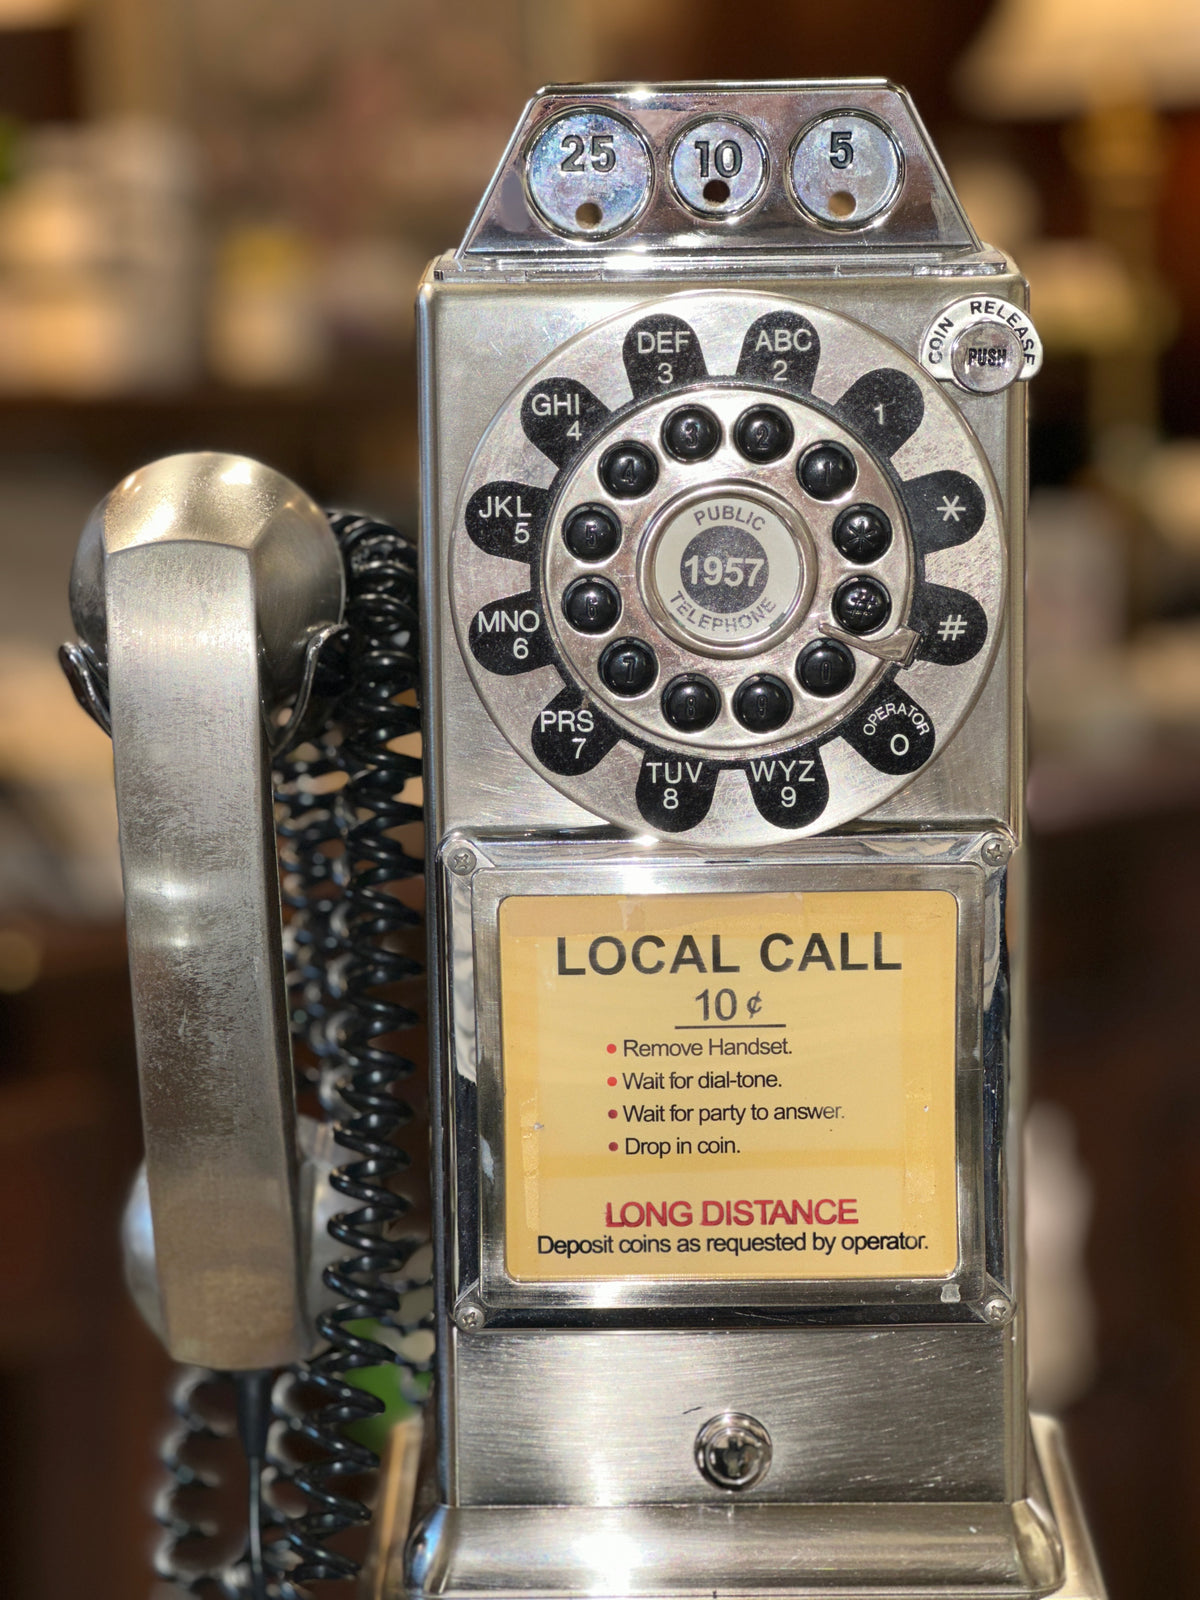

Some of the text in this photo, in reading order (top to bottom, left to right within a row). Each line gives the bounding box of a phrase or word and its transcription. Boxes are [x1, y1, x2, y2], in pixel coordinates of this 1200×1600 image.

[560, 135, 616, 172] 25
[694, 140, 743, 178] 10
[829, 131, 854, 169] 5
[637, 331, 691, 354] DEF
[755, 329, 812, 352] ABC
[928, 300, 1035, 365] COIN RELEASE
[967, 347, 1007, 366] PUSH
[657, 362, 674, 384] 3
[773, 360, 788, 381] 2
[531, 393, 580, 416] GHI
[873, 403, 884, 425] 1
[566, 420, 582, 441] 4
[478, 496, 533, 519] JKL
[693, 505, 766, 532] PUBLIC
[514, 522, 530, 544] 5
[684, 554, 765, 587] 1957
[478, 610, 540, 633] MNO
[670, 590, 777, 632] TELEPHONE
[512, 637, 529, 660] 6
[540, 710, 595, 733] PRS
[863, 703, 930, 736] OPERATOR
[571, 738, 587, 759] 7
[646, 761, 703, 784] TUV
[750, 760, 816, 783] WYZ
[662, 788, 679, 810] 8
[780, 786, 797, 808] 9
[556, 931, 903, 977] LOCAL CALL
[695, 987, 738, 1022] 10
[623, 1037, 793, 1058] Remove Handset.
[622, 1071, 783, 1090] Wait for dial-tone.
[622, 1103, 846, 1126] Wait for party to answer.
[625, 1136, 741, 1159] Drop in coin.
[605, 1198, 859, 1228] LONG DISTANCE
[537, 1231, 929, 1259] Deposit coins as requested by operator.
